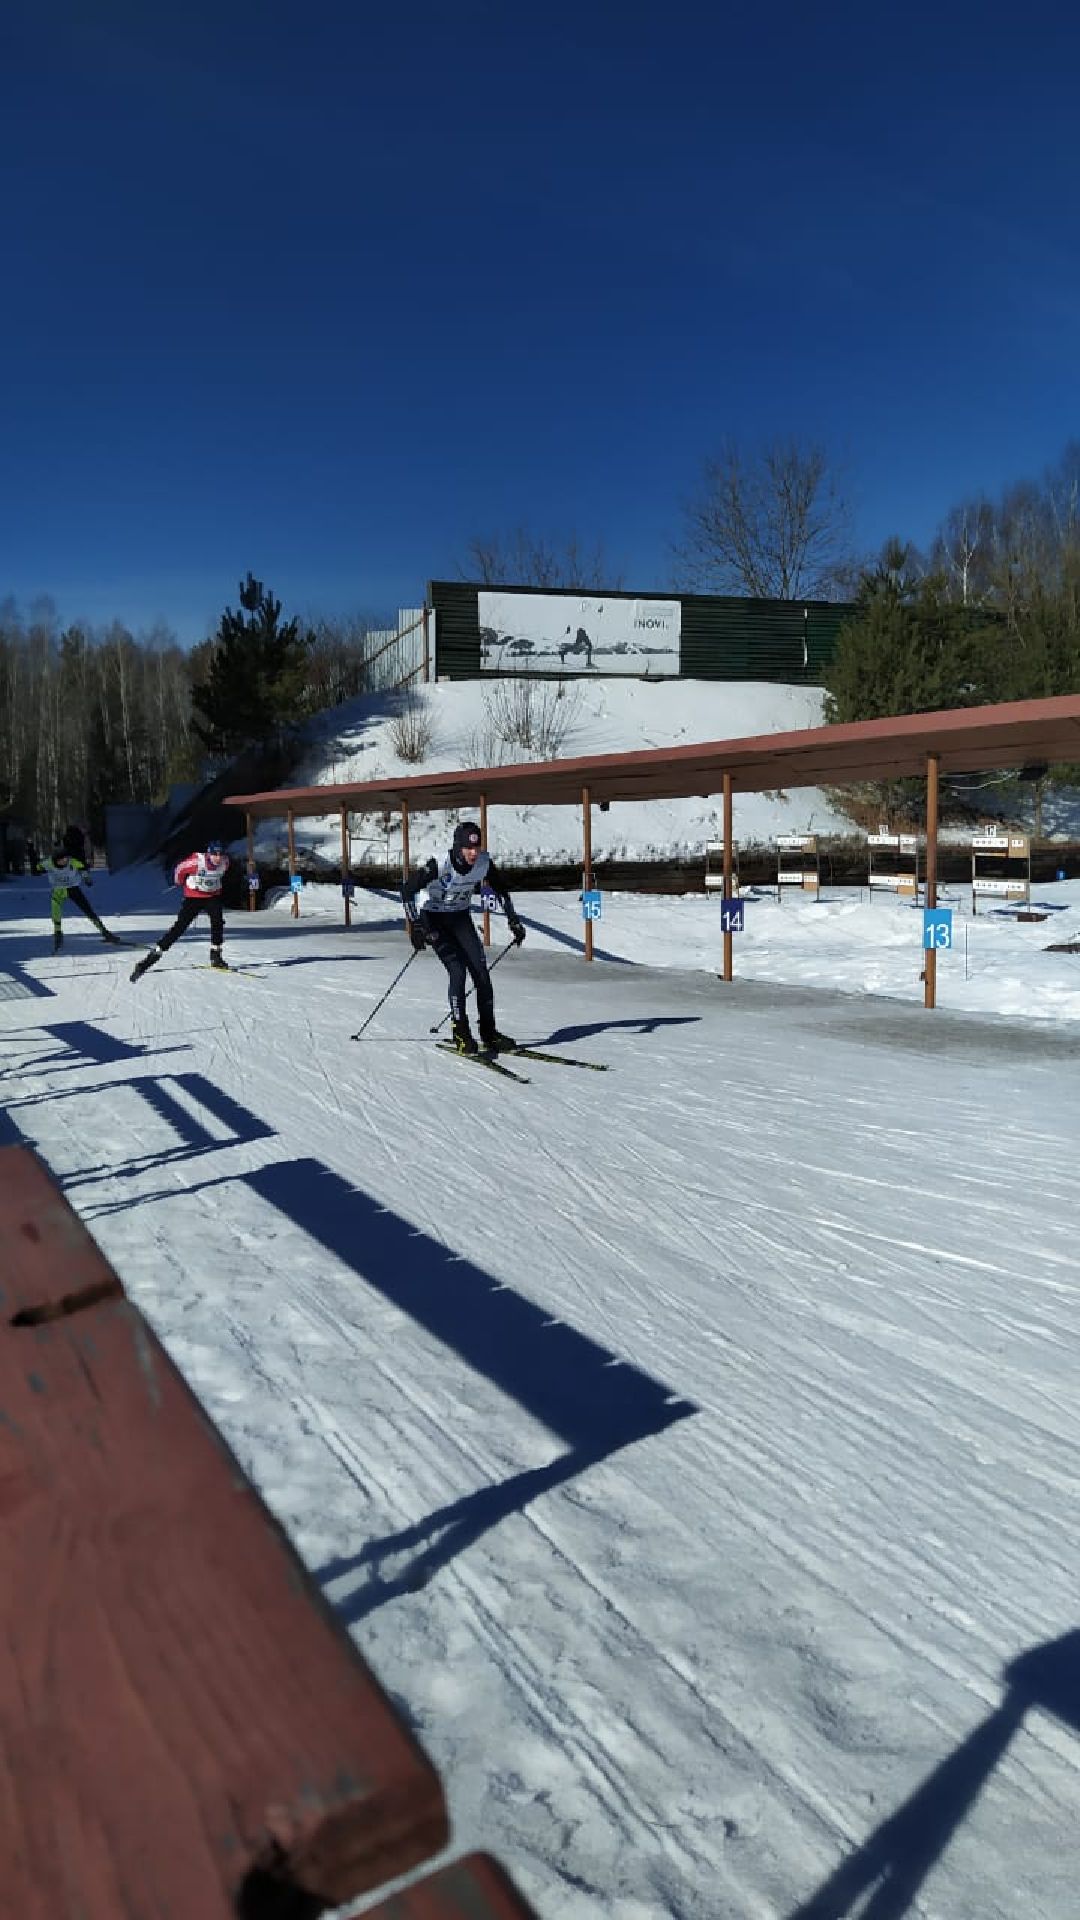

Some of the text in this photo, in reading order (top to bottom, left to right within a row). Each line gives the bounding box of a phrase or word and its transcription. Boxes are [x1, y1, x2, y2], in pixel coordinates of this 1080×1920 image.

[584, 900, 601, 920] 15
[722, 911, 743, 931] 14
[926, 923, 950, 949] 13
